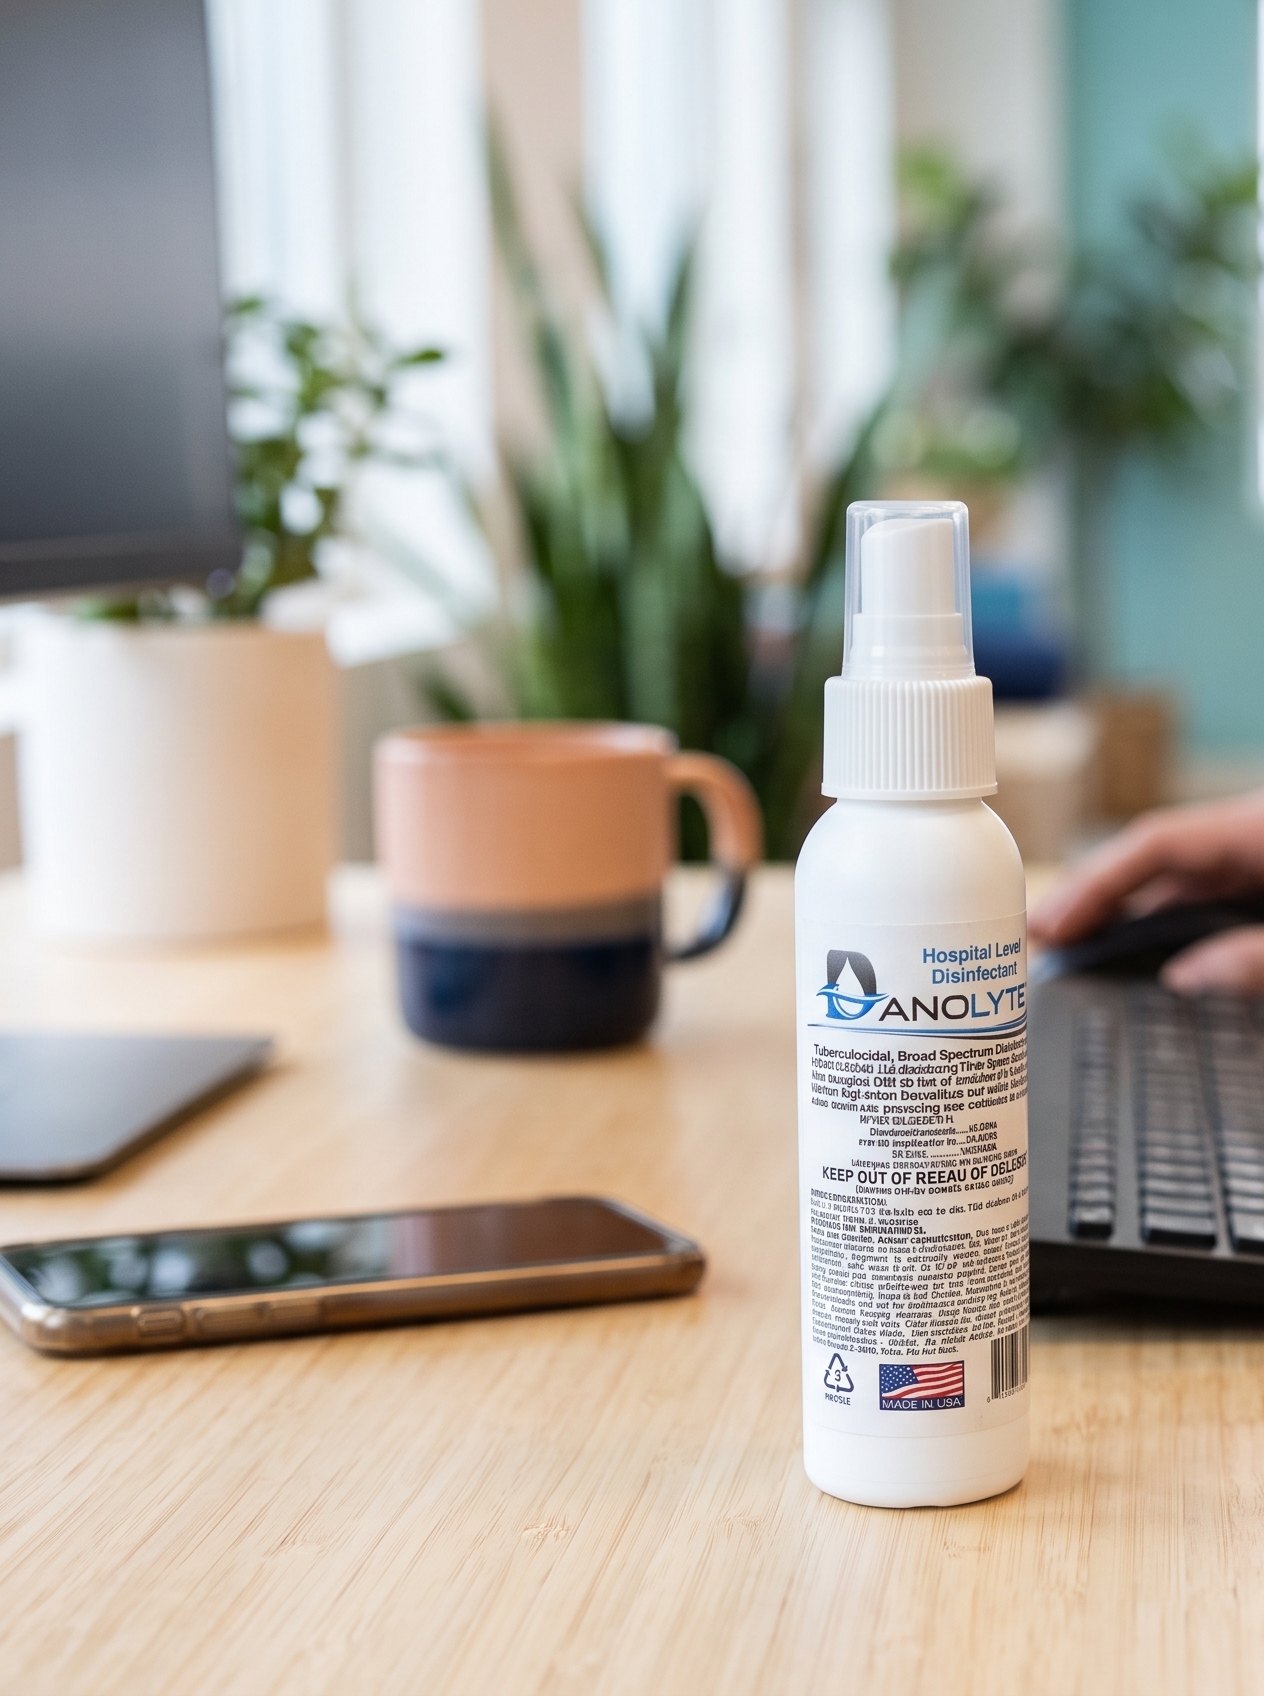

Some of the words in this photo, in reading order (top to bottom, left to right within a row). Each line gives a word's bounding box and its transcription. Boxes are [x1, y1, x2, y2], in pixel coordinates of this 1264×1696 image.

[922, 943, 992, 965] Hospital
[996, 937, 1021, 953] Level
[931, 961, 1018, 984] Disinfectant
[813, 1043, 895, 1064] Tuberculocidal,
[898, 1050, 937, 1062] Broad
[939, 1047, 994, 1063] Spectrum
[822, 1166, 854, 1183] KEEP
[857, 1171, 887, 1185] OUT
[891, 1171, 911, 1185] OF
[915, 1169, 967, 1184] REEAU
[970, 1165, 987, 1180] OF
[882, 1399, 918, 1410] MADE
[921, 1399, 934, 1409] IN
[937, 1398, 961, 1408] USA
